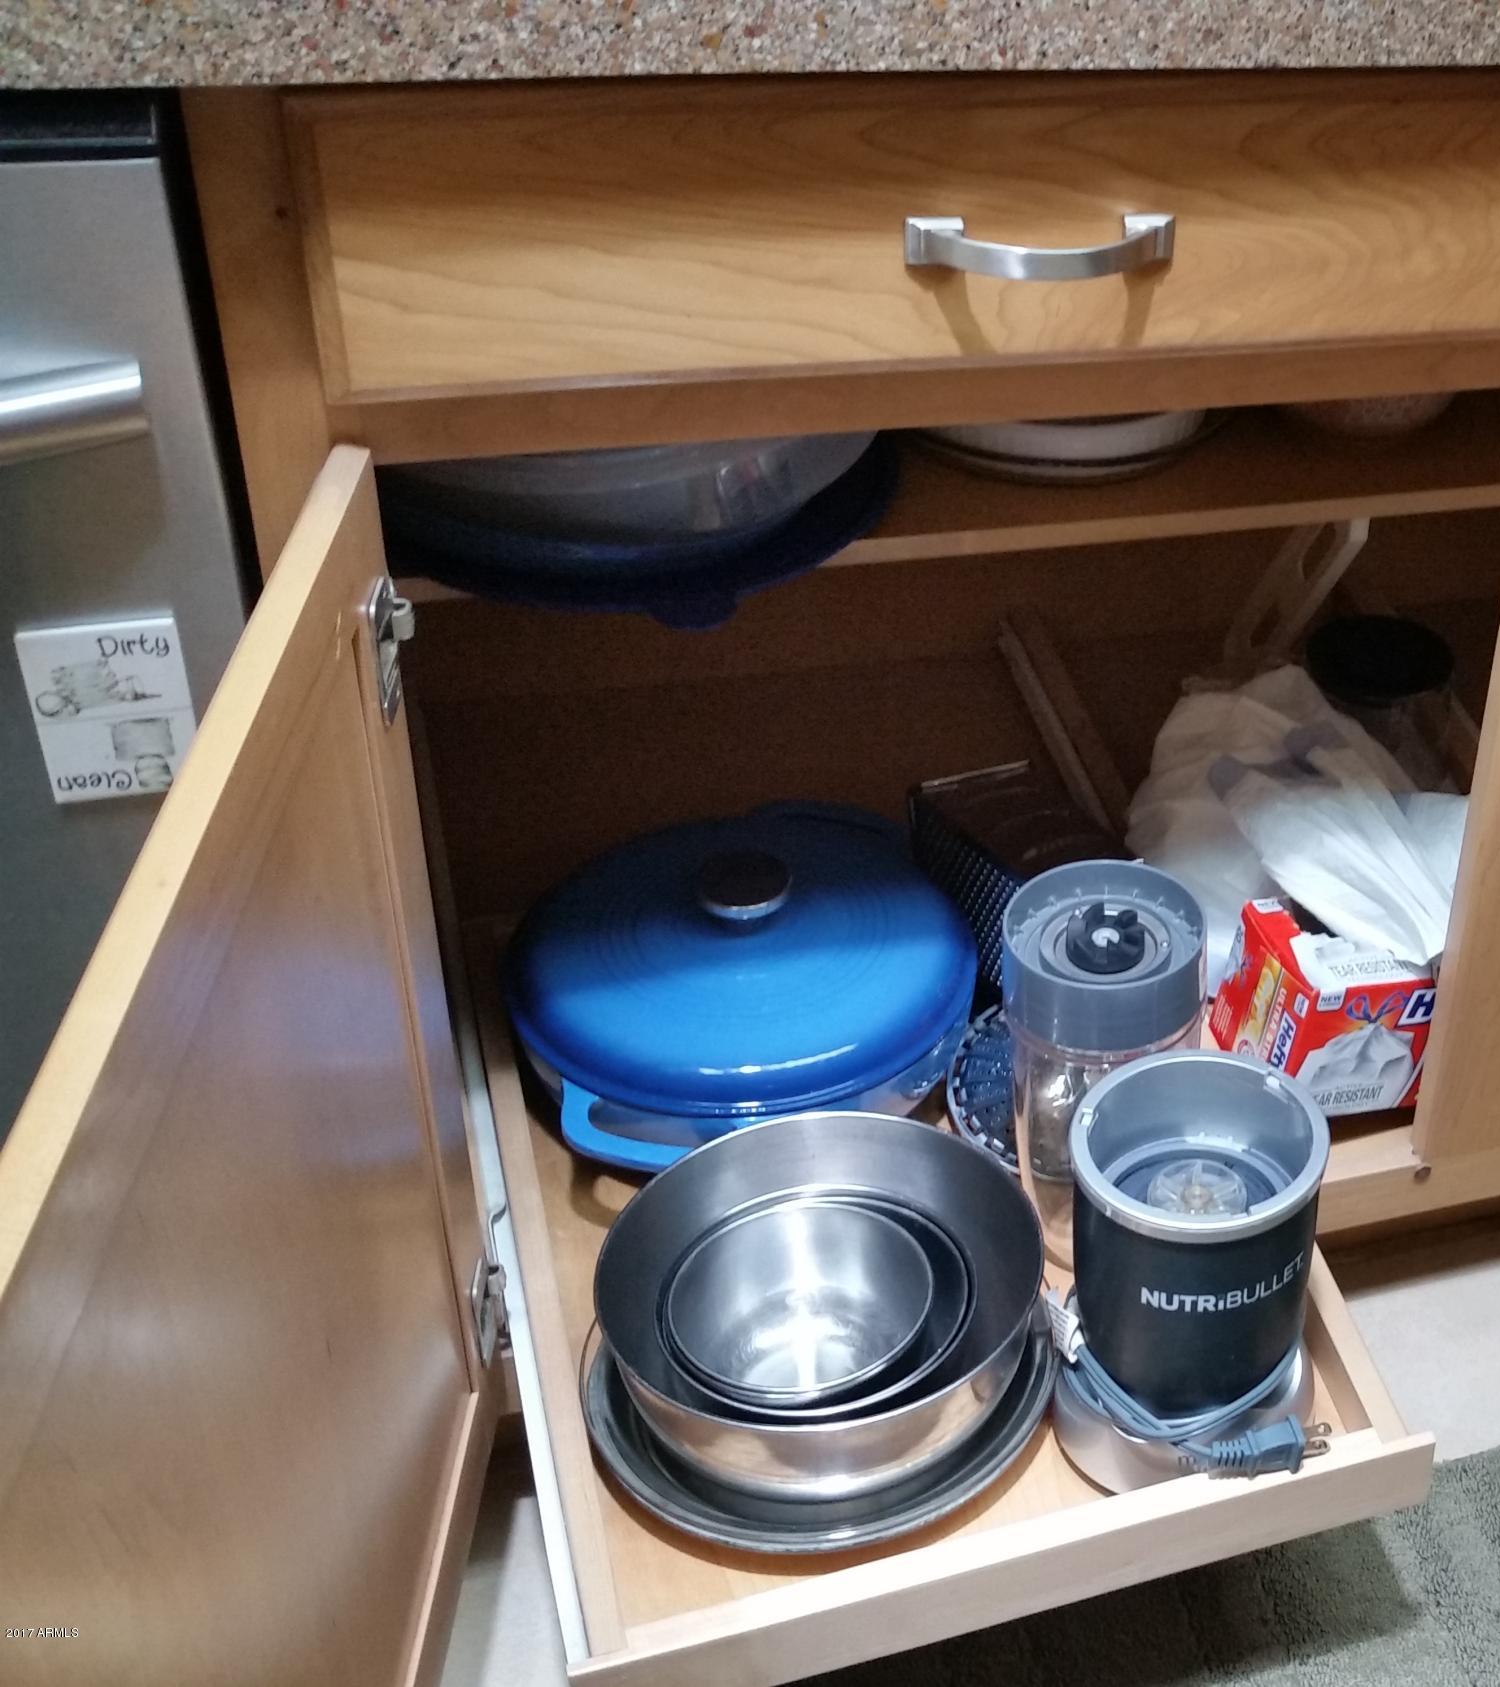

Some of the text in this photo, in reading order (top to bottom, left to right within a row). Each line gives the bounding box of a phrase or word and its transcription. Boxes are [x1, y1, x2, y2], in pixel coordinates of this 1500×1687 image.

[96, 632, 170, 658] Dirty
[56, 769, 133, 792] Clean
[1333, 1086, 1384, 1105] RESISTANT
